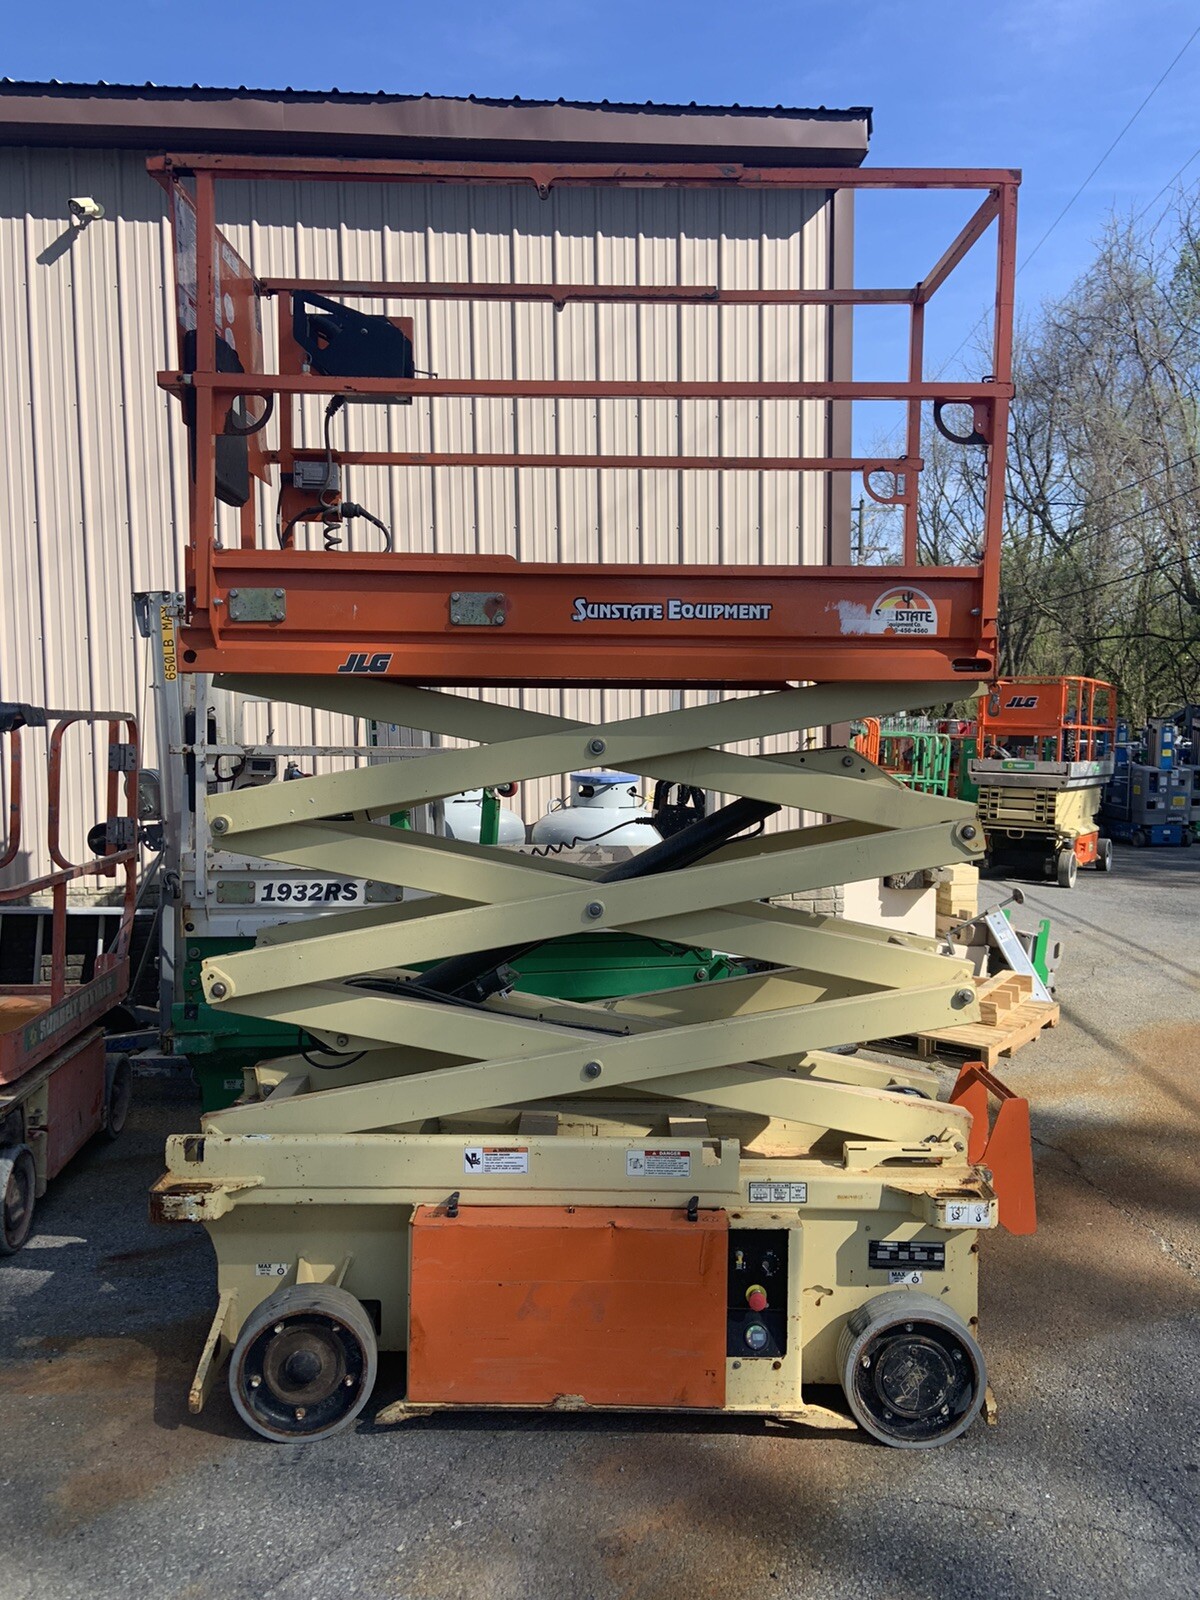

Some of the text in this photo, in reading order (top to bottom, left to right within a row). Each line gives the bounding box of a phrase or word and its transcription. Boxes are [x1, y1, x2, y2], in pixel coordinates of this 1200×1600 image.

[163, 639, 177, 680] 650LB
[337, 652, 394, 674] JLG
[1005, 696, 1039, 708] JLG
[260, 882, 359, 902] 1932RS
